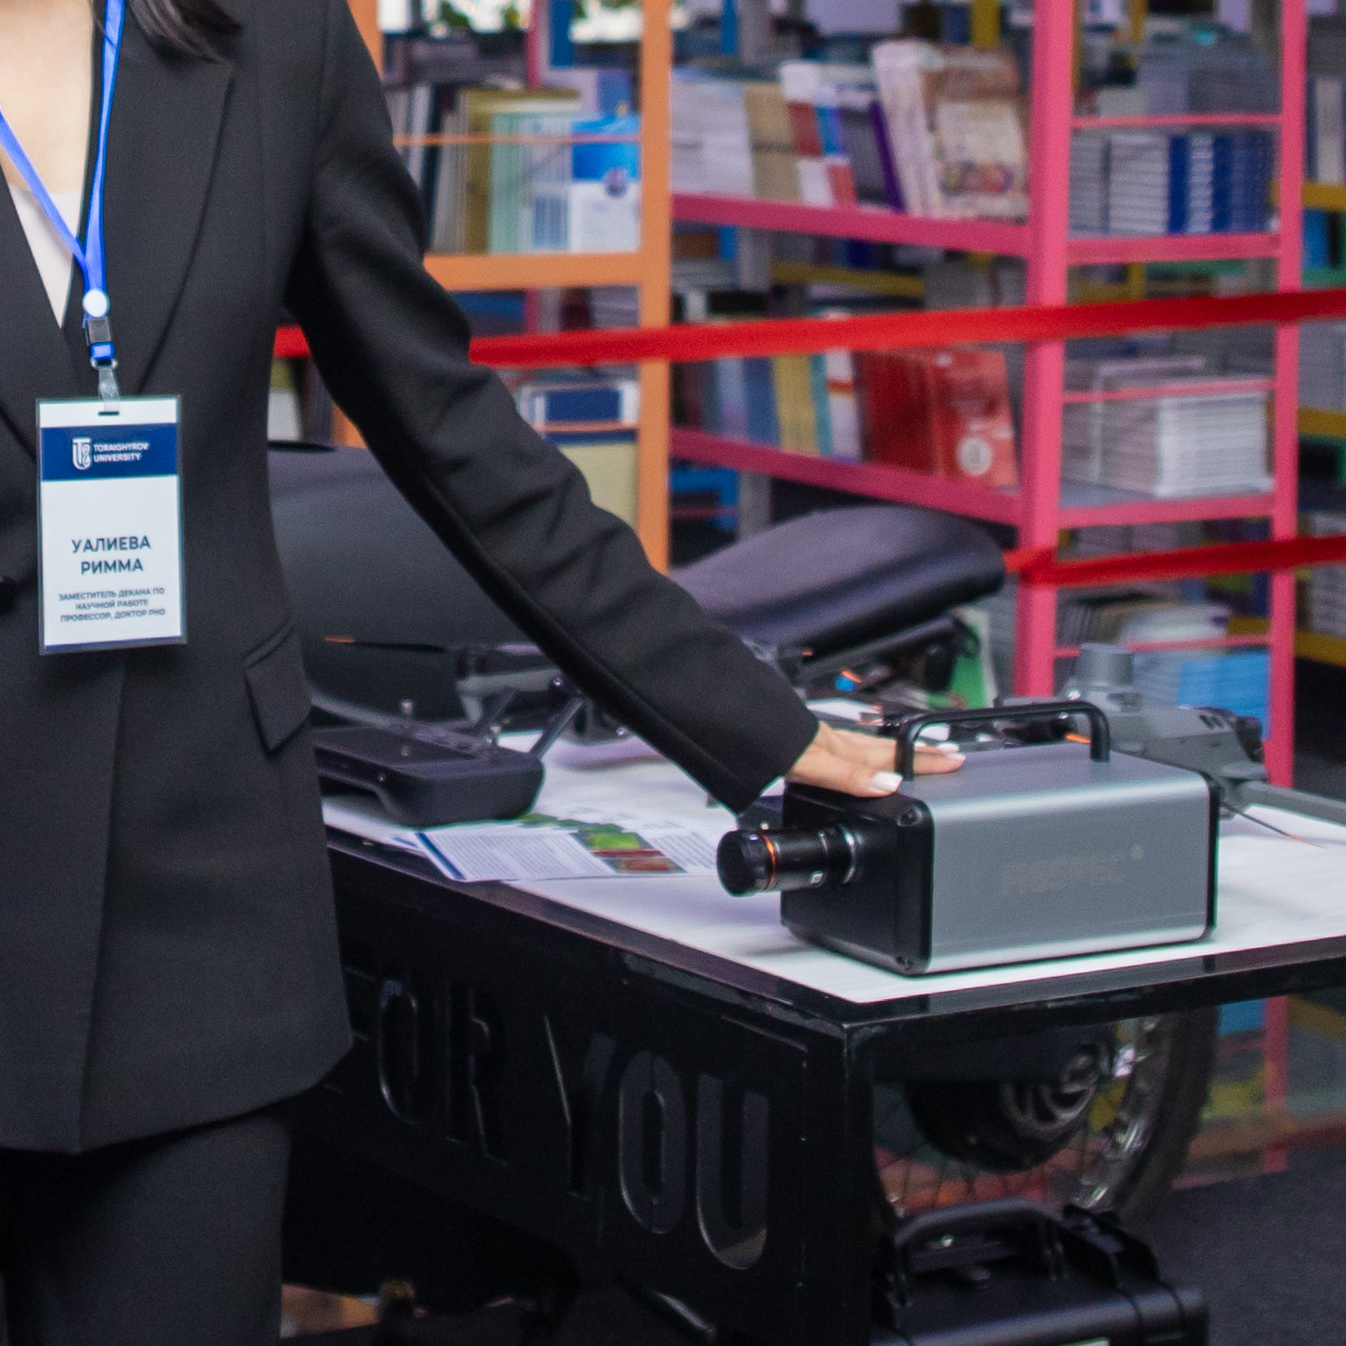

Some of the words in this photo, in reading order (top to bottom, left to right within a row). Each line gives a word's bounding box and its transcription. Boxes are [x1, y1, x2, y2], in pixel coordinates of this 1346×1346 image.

[93, 453, 142, 462] UNIVERSITY
[71, 535, 151, 553] УАЛИЕВА
[80, 558, 144, 575] РИММА
[59, 591, 116, 601] ЗАМЕСТИТЕЛЬ
[118, 588, 151, 598] ДЕКАНА
[153, 587, 165, 595] ПО
[75, 600, 115, 610] НАУЧНОЙ
[117, 599, 149, 607] РАБОТЕ
[114, 609, 147, 619] ДОКТОР
[542, 1013, 771, 1271] YOU
